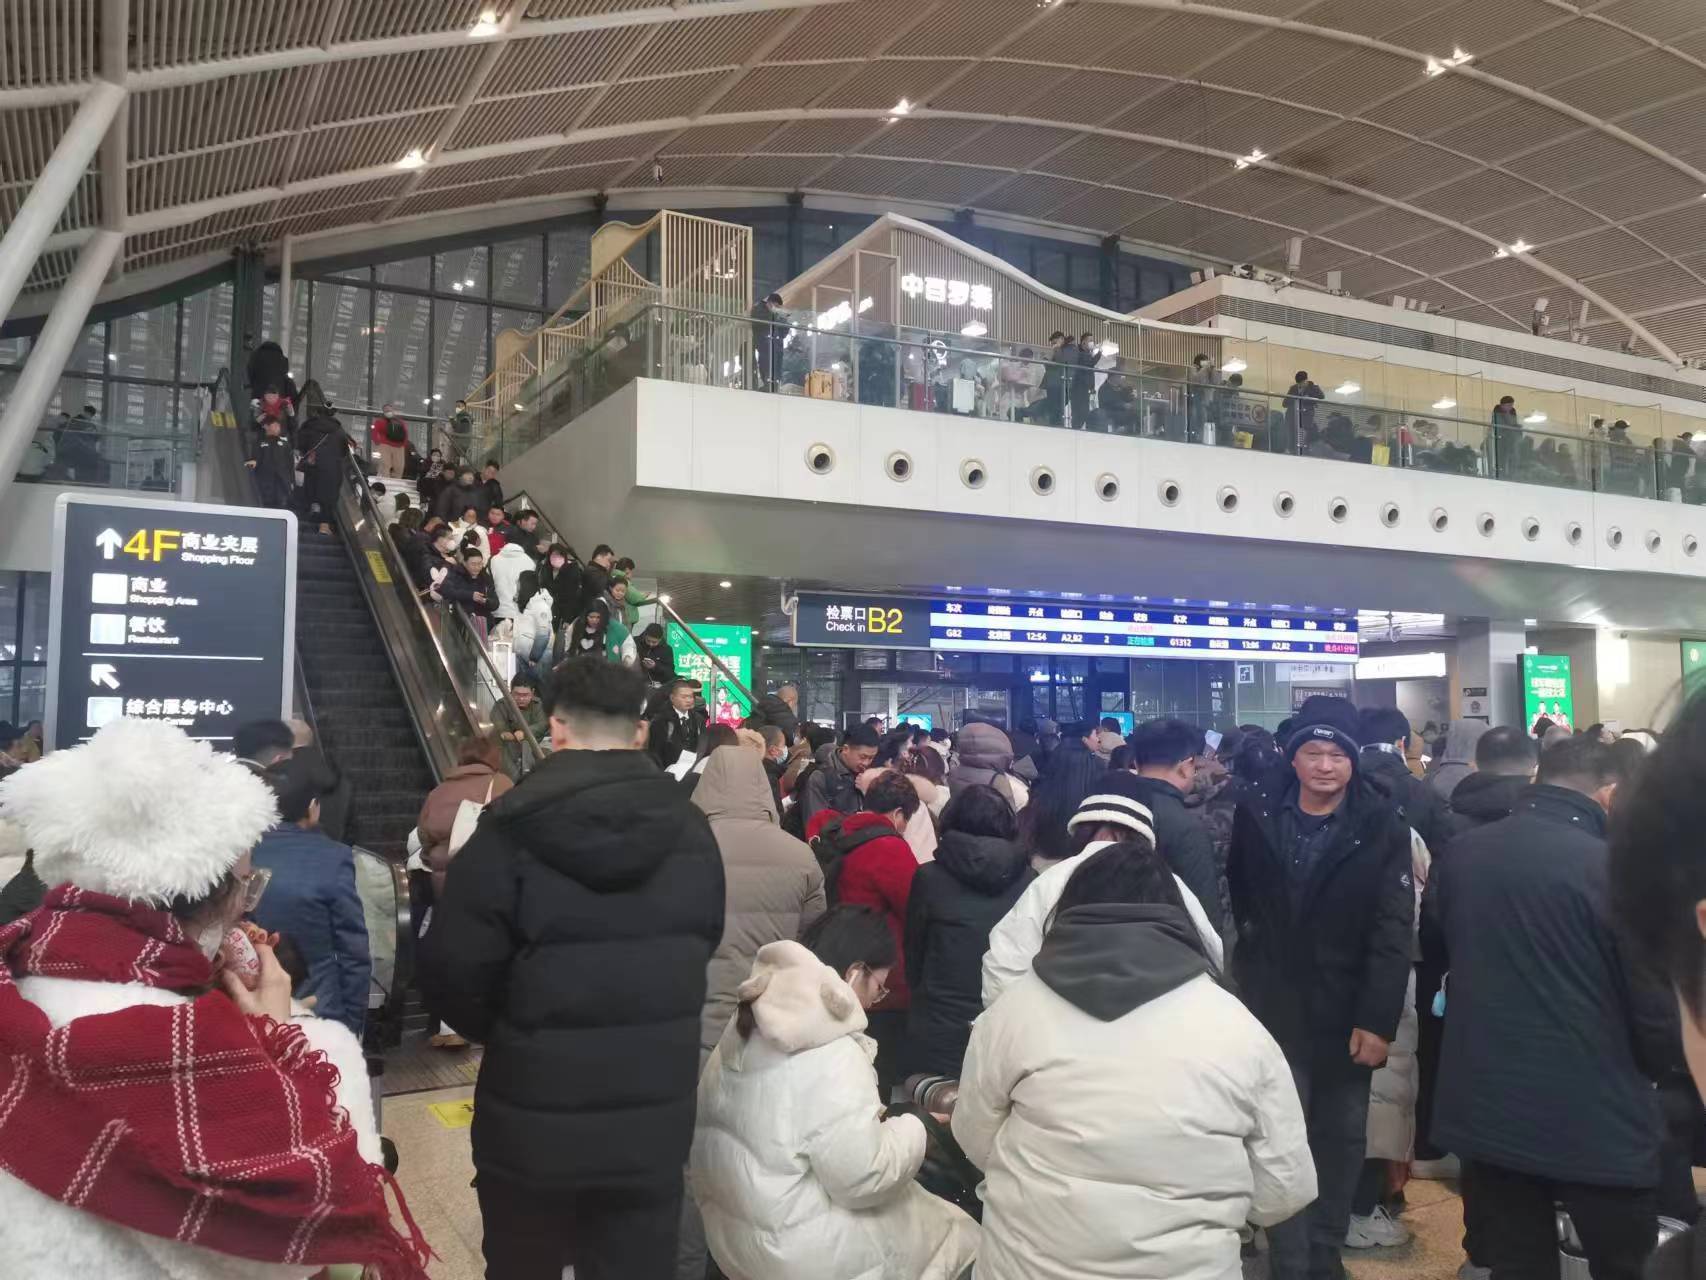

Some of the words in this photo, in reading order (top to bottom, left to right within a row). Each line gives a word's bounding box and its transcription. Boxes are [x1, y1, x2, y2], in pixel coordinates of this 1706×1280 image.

[124, 529, 180, 562] 4F
[181, 532, 258, 553] 商业夹层
[181, 552, 228, 566] Shopping
[229, 555, 256, 566] Floor
[131, 576, 167, 593] 商业
[129, 594, 174, 606] Shopping
[175, 597, 199, 606] Area
[826, 605, 866, 620] 检票口
[868, 607, 903, 634] B2
[129, 616, 166, 633] 餐饮
[825, 621, 855, 632] Check
[857, 622, 866, 632] in
[128, 634, 180, 645] Restaurant
[126, 698, 234, 715] 综合服务中心
